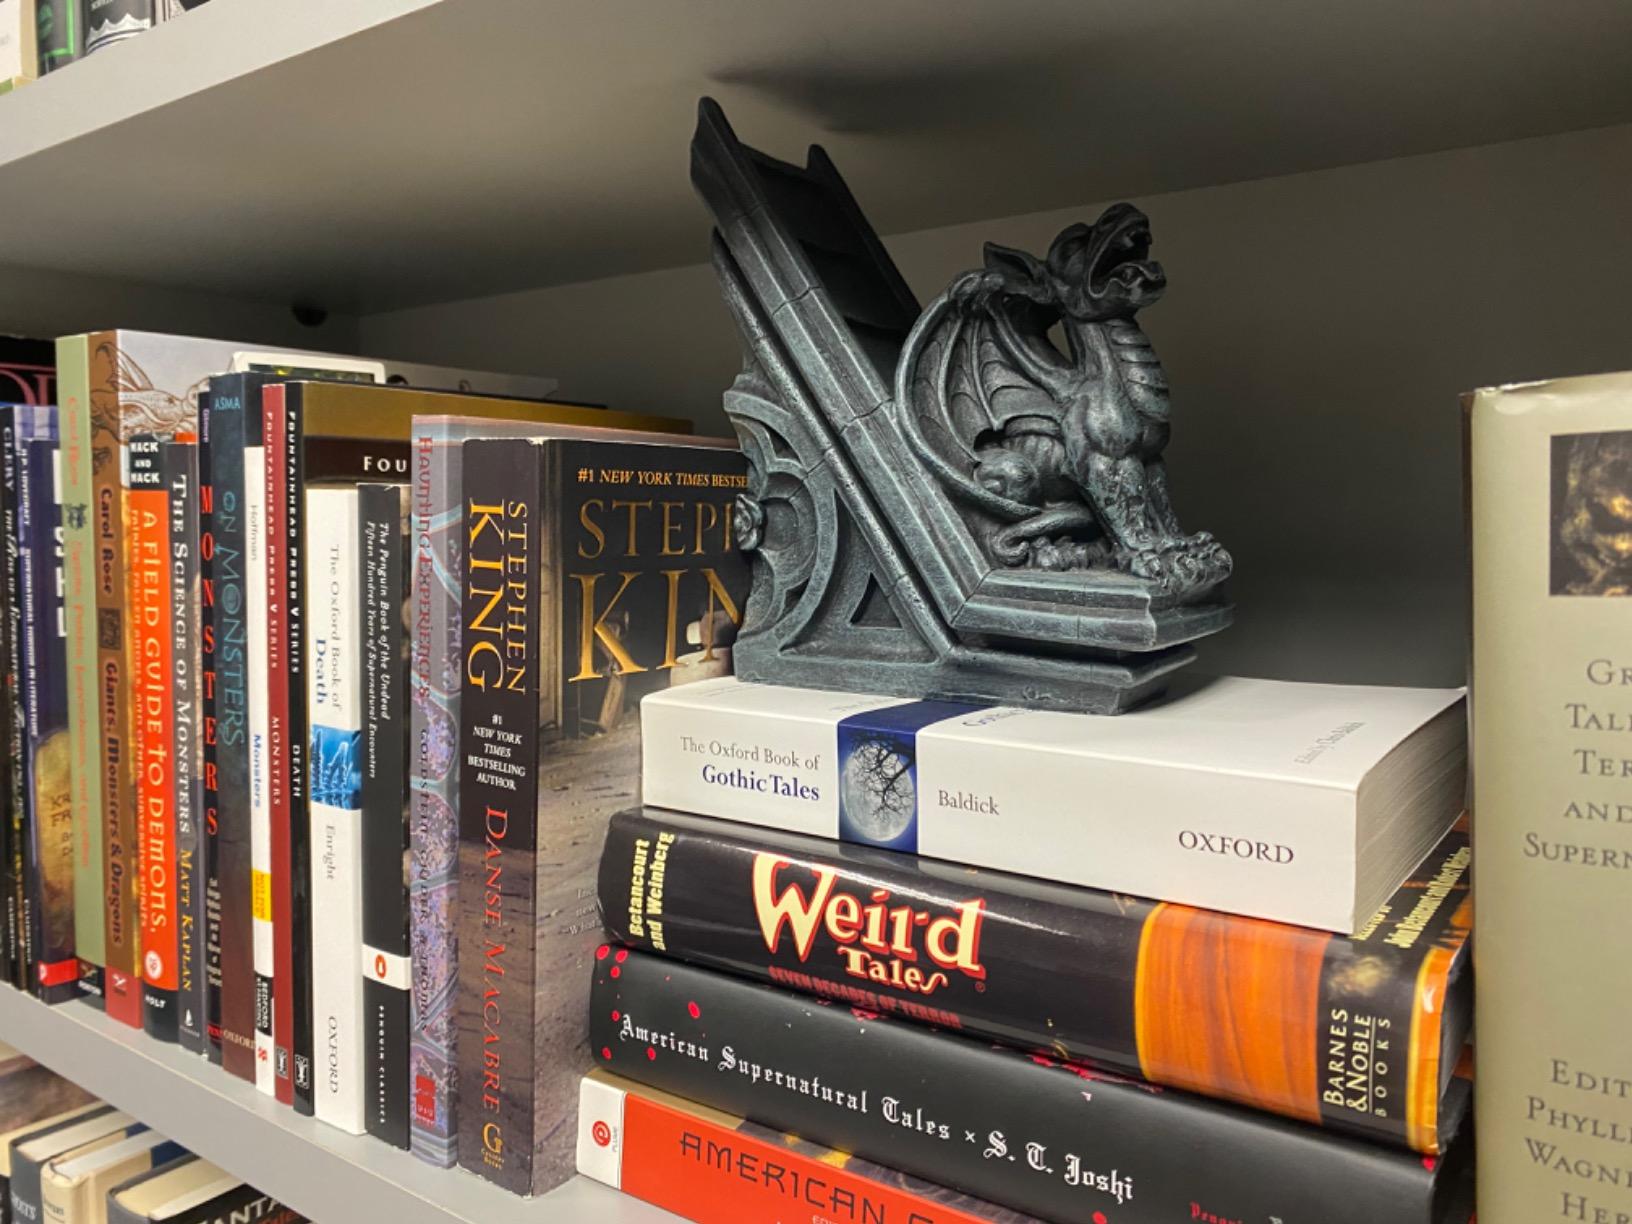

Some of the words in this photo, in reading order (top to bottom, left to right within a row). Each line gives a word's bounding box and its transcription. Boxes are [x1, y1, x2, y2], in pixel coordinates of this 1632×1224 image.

[202, 408, 210, 442] Gilmore
[214, 397, 241, 410] ASMA
[3, 426, 15, 491] CLERY
[288, 411, 297, 538] FOUNTAINHEAD
[577, 467, 594, 483] #1
[600, 470, 634, 484] NEW
[637, 470, 672, 486] YORK
[676, 472, 710, 487] TIMES
[101, 488, 114, 538] Carol
[143, 511, 158, 527] A
[172, 474, 187, 532] THE
[222, 491, 237, 532] ON
[250, 505, 260, 560] Hoffman
[366, 521, 377, 557] Fifteen
[379, 522, 390, 544] The
[103, 548, 114, 595] Rose
[143, 541, 162, 626] FIELD
[289, 547, 298, 600] PRESS
[330, 544, 341, 575] The
[367, 561, 377, 605] Hundred
[377, 549, 390, 596] Penguin
[173, 542, 189, 649] SCIENCE
[270, 604, 278, 612] V
[291, 607, 300, 616] V
[330, 581, 342, 640] Oxford
[380, 600, 390, 631] Book
[467, 498, 505, 692] KING
[507, 502, 529, 696] STEPHEN
[222, 549, 245, 746] MONSTERS
[271, 620, 279, 669] SERIES
[291, 623, 300, 673] SERIES
[367, 639, 377, 651] of
[368, 610, 377, 636] Years
[379, 634, 391, 651] of
[175, 659, 187, 691] OF
[316, 639, 328, 704] Death
[331, 646, 342, 688] Book
[380, 651, 390, 668] the
[105, 662, 119, 732] Giants,
[146, 637, 165, 733] GUIDE
[332, 693, 343, 711] of
[366, 652, 377, 720] Supernatural
[381, 673, 391, 720] Undead
[369, 723, 378, 778] Encounters
[473, 726, 495, 738] NEW
[497, 730, 522, 744] YORK
[484, 743, 511, 757] TIMES
[680, 736, 706, 754] The
[710, 739, 759, 762] Oxford
[764, 746, 800, 768] Book
[804, 755, 820, 771] of
[148, 744, 167, 786] TO
[176, 700, 192, 834] MONSTERS
[253, 734, 261, 807] Monsters
[272, 716, 281, 806] MONSTERS
[292, 744, 301, 797] DEATH
[467, 755, 526, 777] BESTSELLING
[476, 772, 516, 790] AUTHOR
[702, 764, 767, 792] Gothic
[769, 775, 820, 801] Tales
[107, 737, 121, 838] Monsters
[938, 790, 1000, 815] Baldick
[1563, 801, 1632, 824] AND
[111, 843, 124, 856] &
[323, 825, 336, 880] Enright
[485, 806, 508, 928] DANSE
[1178, 830, 1295, 865] OXFORD
[180, 849, 193, 906] MATT
[628, 838, 650, 938] Betancourt
[647, 832, 675, 916] Weinberg
[109, 862, 124, 944] Dragons
[752, 851, 987, 981] Weird
[181, 914, 195, 993] KAPLAN
[651, 920, 667, 952] and
[836, 944, 948, 995] Tales
[767, 966, 813, 988] SEVEN
[812, 977, 877, 1005] DECADES
[878, 994, 896, 1010] OF
[899, 999, 963, 1028] TERROR
[484, 939, 507, 1113] MACABRE
[328, 1016, 339, 1093] OXFORD
[1323, 1008, 1348, 1106] BARNES
[1375, 1017, 1391, 1117] BOOKS
[1551, 1058, 1631, 1099] EDIT
[619, 1013, 710, 1063] American
[718, 1045, 868, 1113] Supernatural
[881, 1096, 950, 1140] Tales
[983, 1130, 1015, 1162] S.
[1025, 1142, 1054, 1174] T.
[1064, 1153, 1133, 1205] Joshi
[1527, 1094, 1632, 1145] PHYLL
[679, 1131, 884, 1224] AMERICAN
